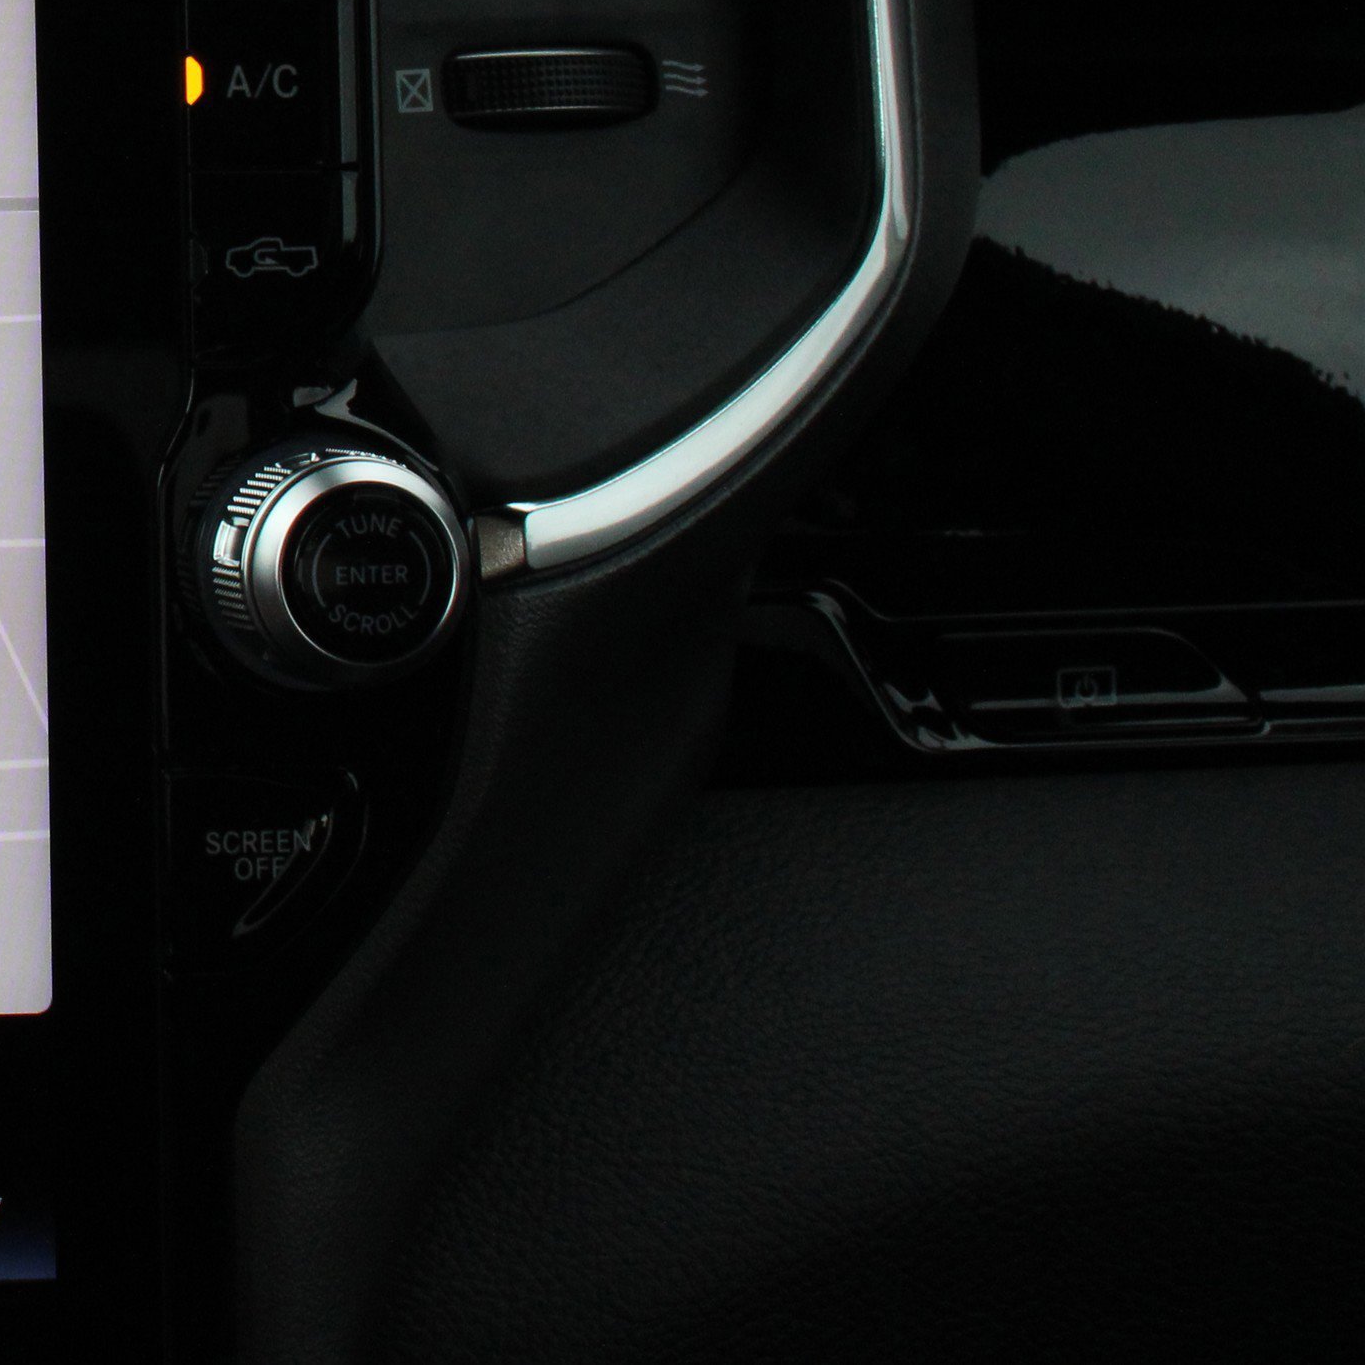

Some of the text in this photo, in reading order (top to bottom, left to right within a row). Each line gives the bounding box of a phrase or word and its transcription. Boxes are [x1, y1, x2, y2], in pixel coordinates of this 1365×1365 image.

[226, 63, 298, 99] A/C
[334, 513, 403, 539] TUNE
[334, 565, 408, 586] ENTER
[328, 602, 420, 636] SCROLL
[205, 829, 312, 855] SCREEN
[234, 856, 287, 882] OFF
